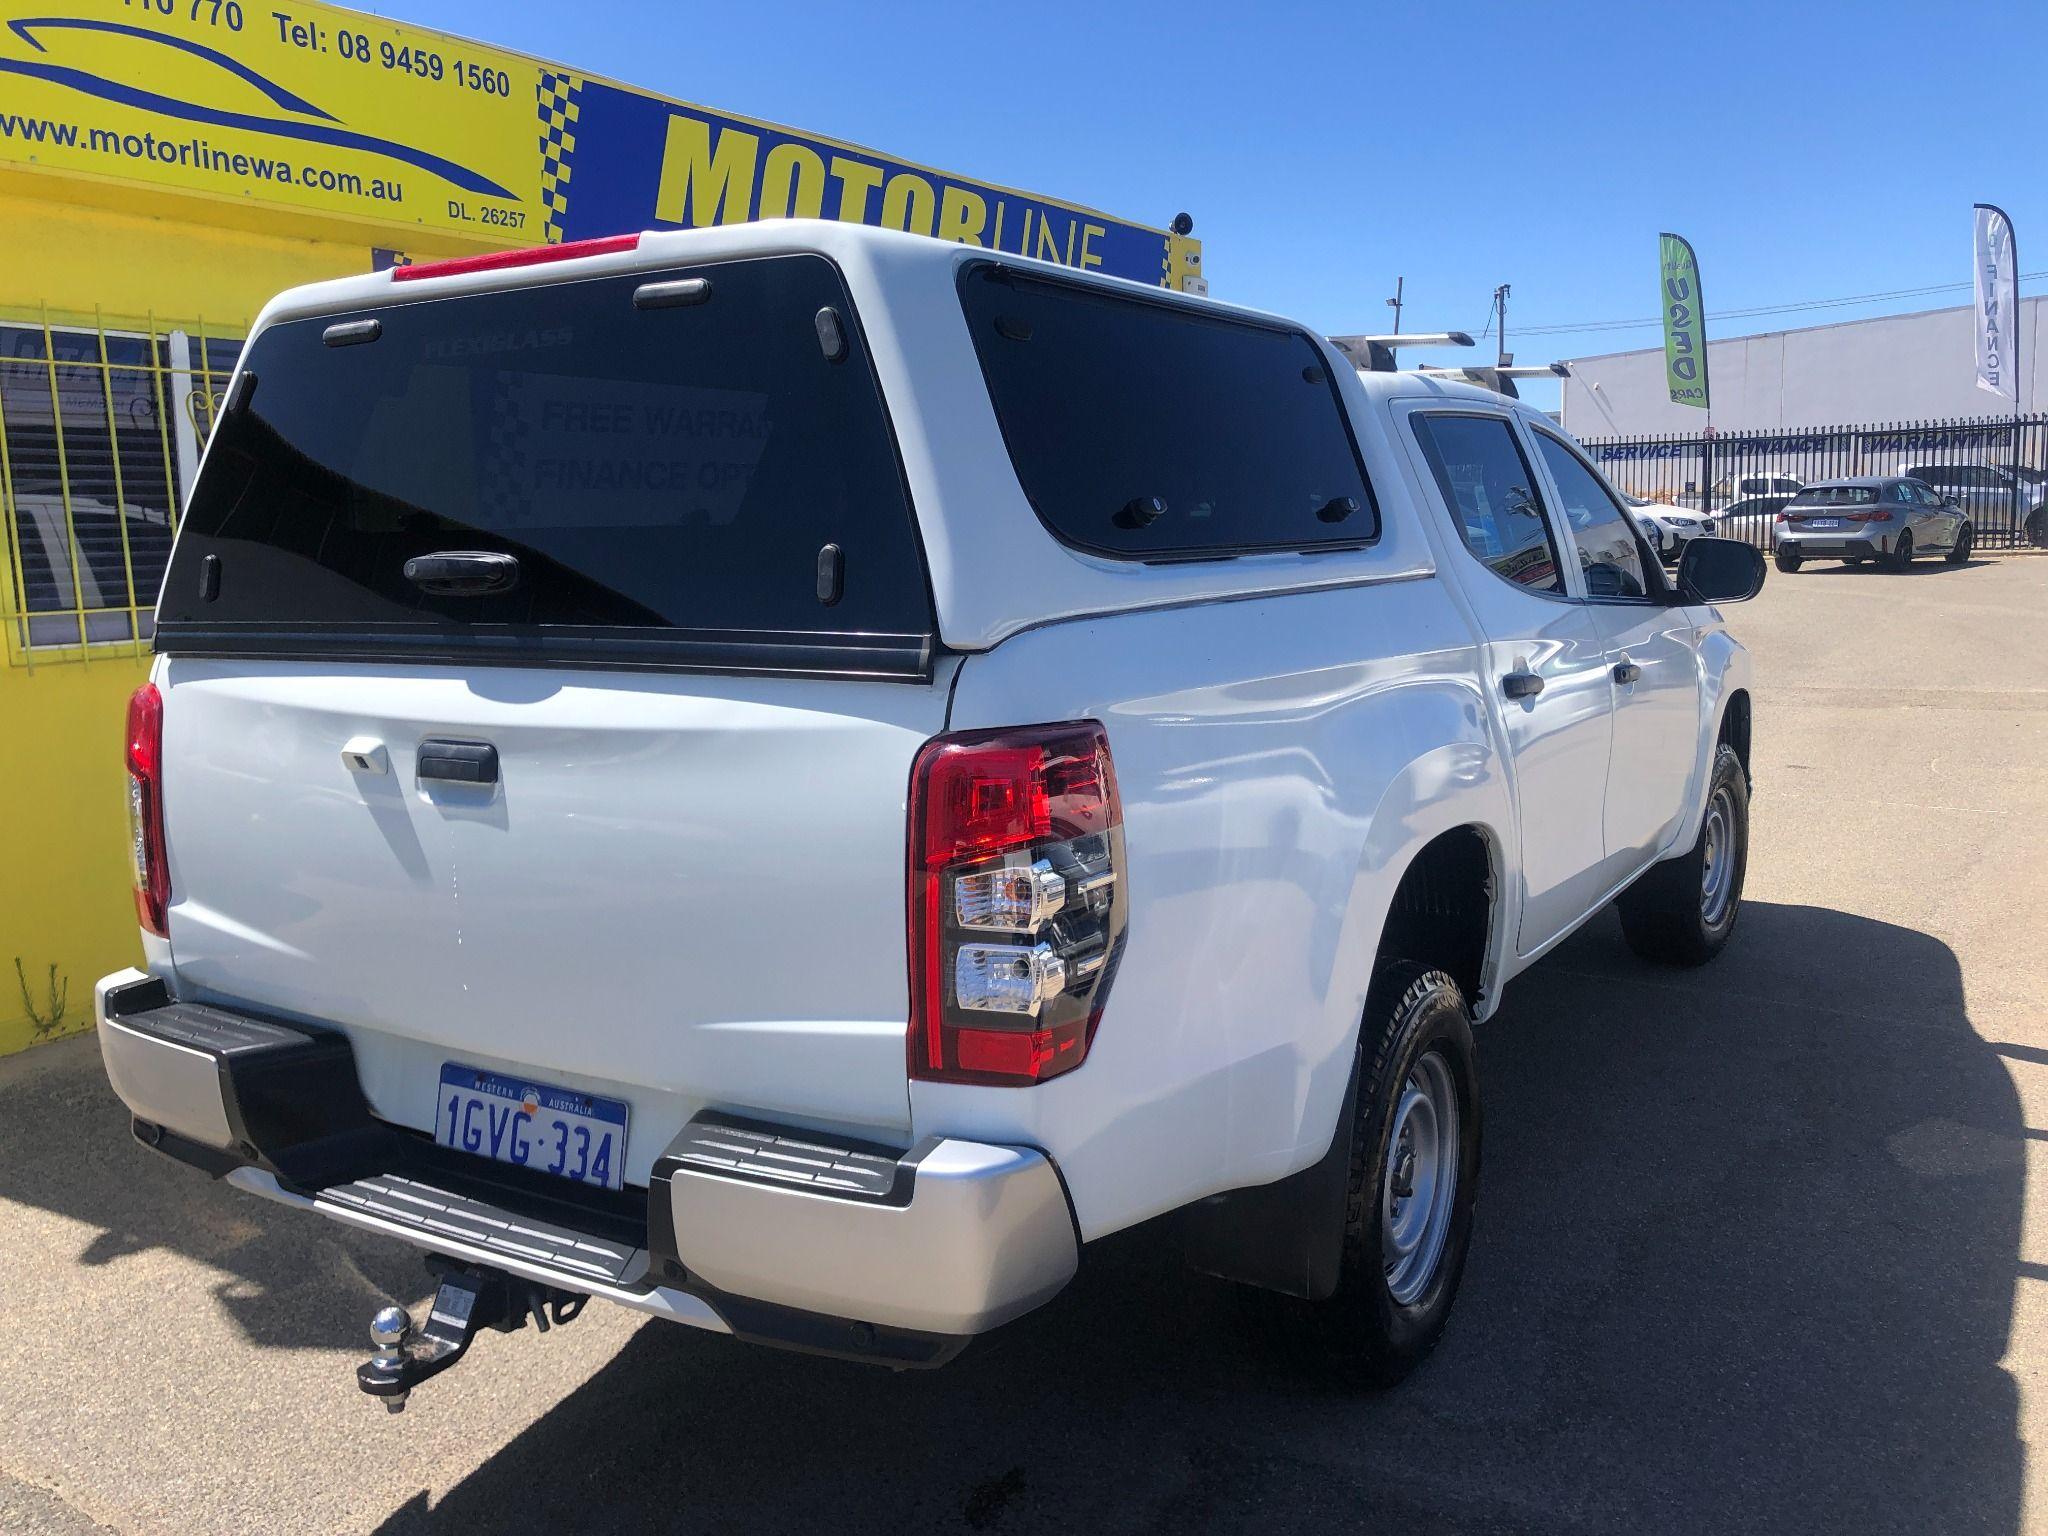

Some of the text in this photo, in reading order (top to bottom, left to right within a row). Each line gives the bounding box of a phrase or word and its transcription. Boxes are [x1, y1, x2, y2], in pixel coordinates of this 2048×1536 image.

[190, 0, 510, 98] 770 Tel: 08 9459 1560
[448, 200, 526, 229] DL. 26257
[1601, 443, 1683, 461] SERVICE
[1736, 437, 1829, 455] FINANCE
[475, 1081, 593, 1117] WESTERN AUSTRALIA
